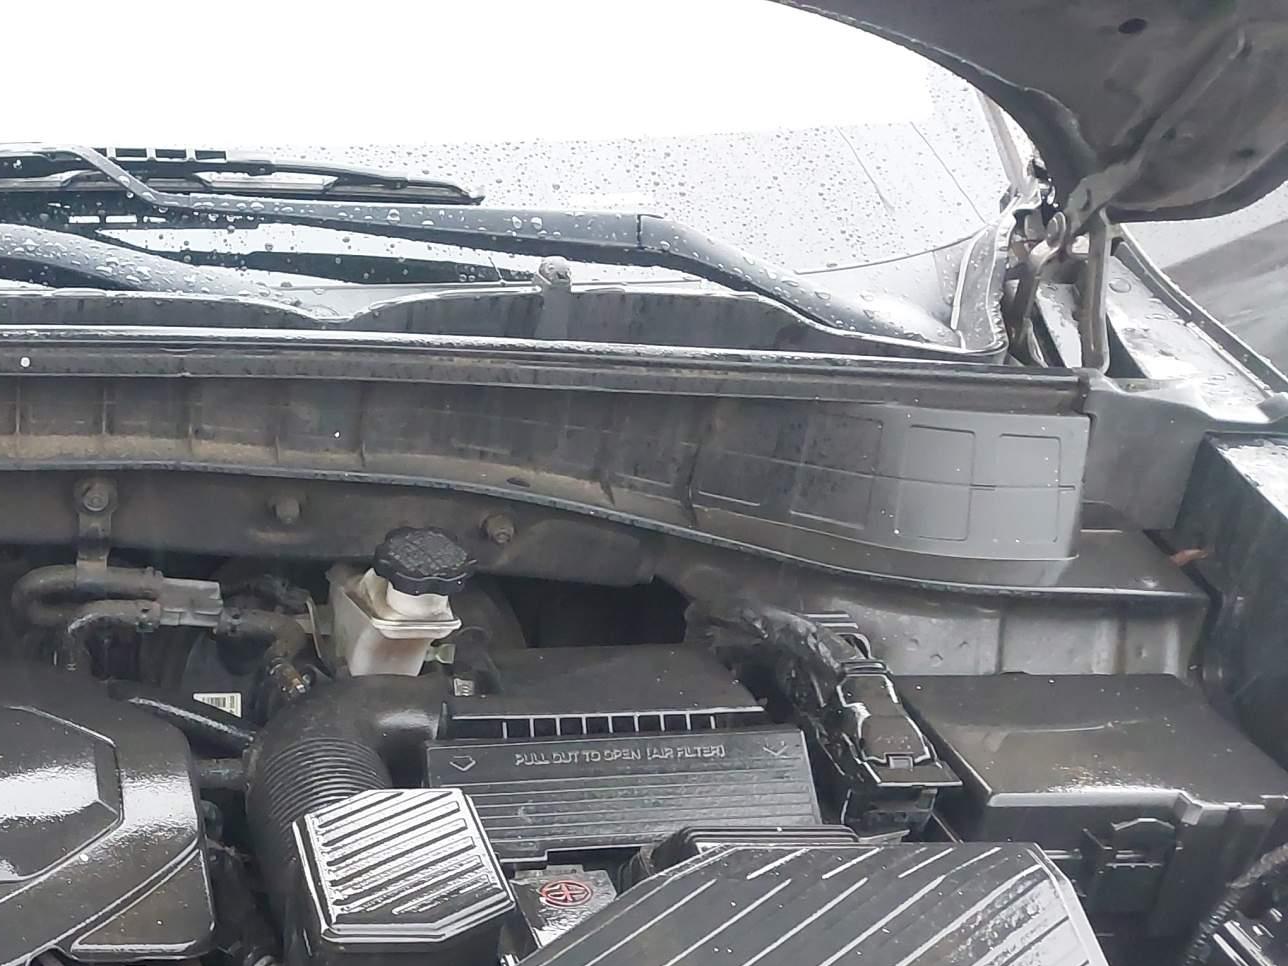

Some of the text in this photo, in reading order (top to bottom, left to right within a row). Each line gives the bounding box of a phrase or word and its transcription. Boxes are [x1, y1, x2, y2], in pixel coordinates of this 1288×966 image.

[514, 752, 550, 766] PULL
[553, 750, 579, 764] OUT
[582, 750, 601, 762] TO
[604, 748, 641, 761] OPEN
